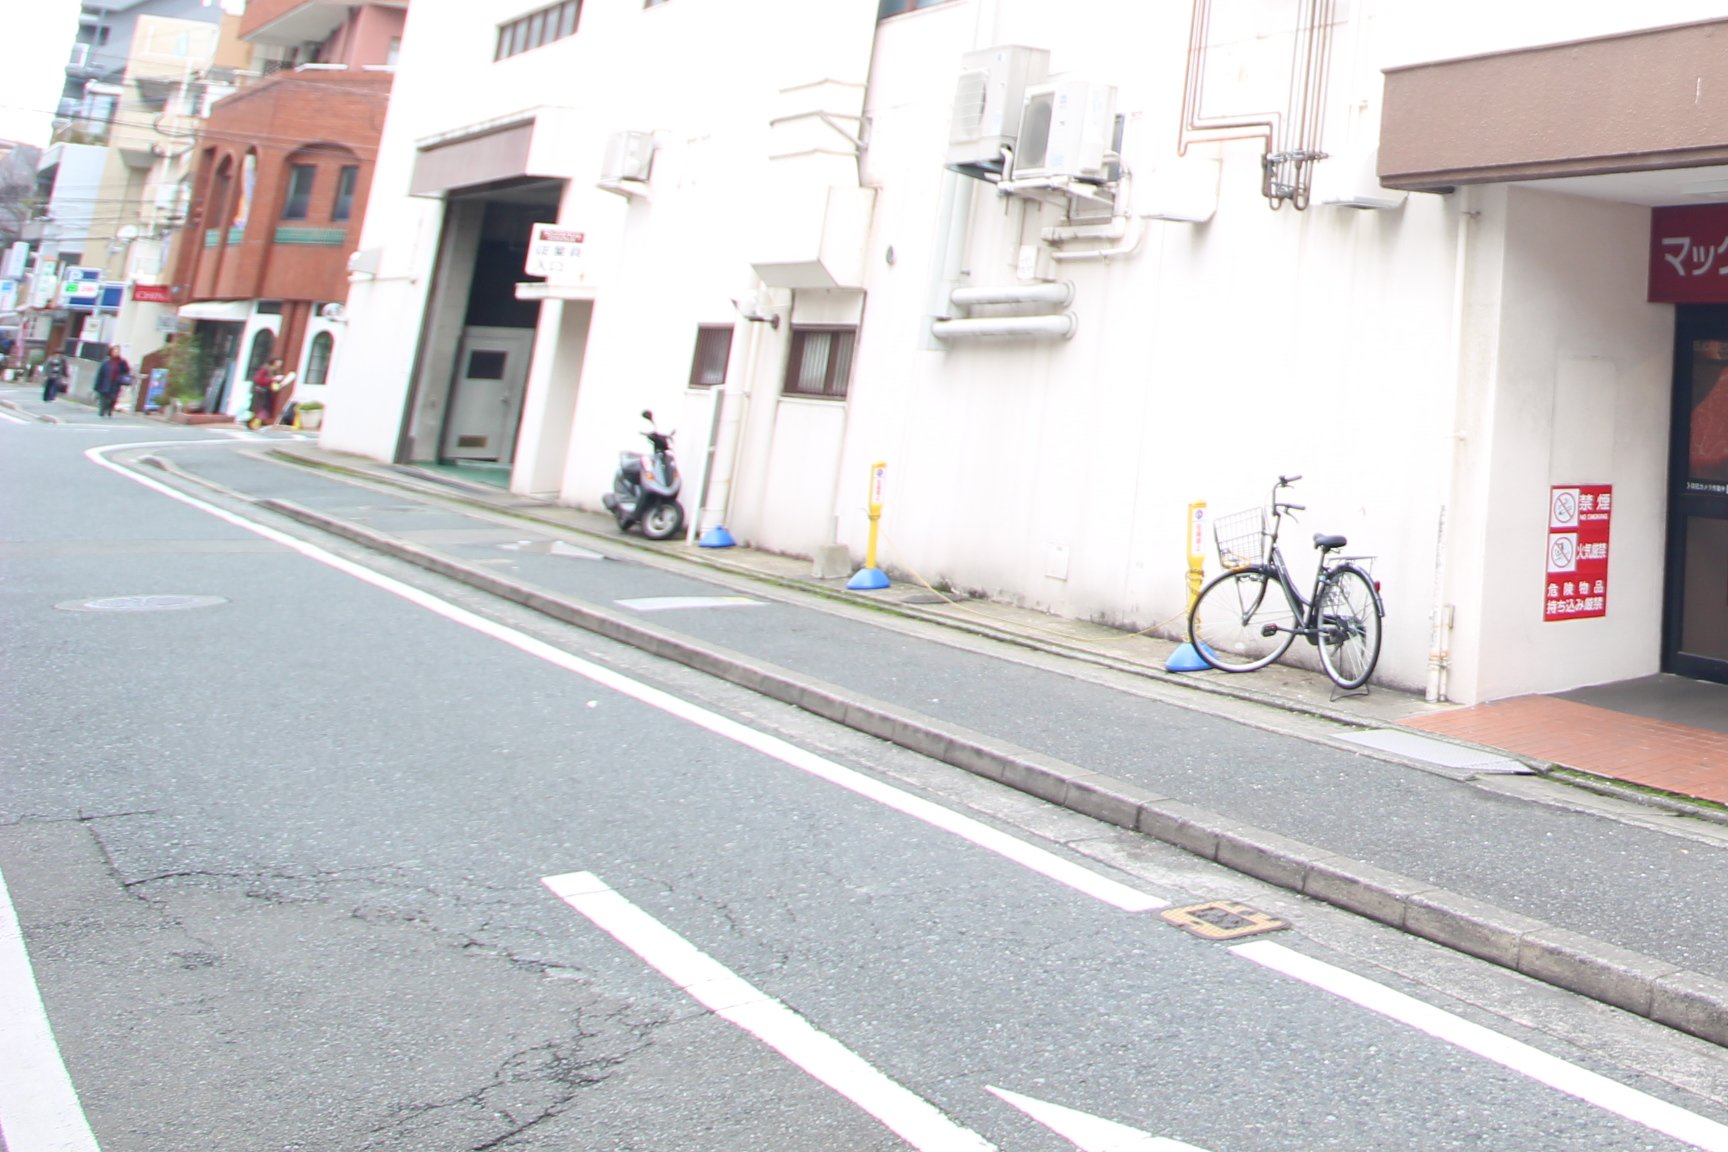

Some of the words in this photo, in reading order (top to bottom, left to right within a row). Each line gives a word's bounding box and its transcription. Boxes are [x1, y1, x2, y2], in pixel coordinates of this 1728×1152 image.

[1578, 493, 1611, 511] 禁煙
[1576, 542, 1608, 560] 火気厳禁
[1547, 579, 1605, 597] 危険物品
[1546, 596, 1605, 615] 持ち込み厳禁
